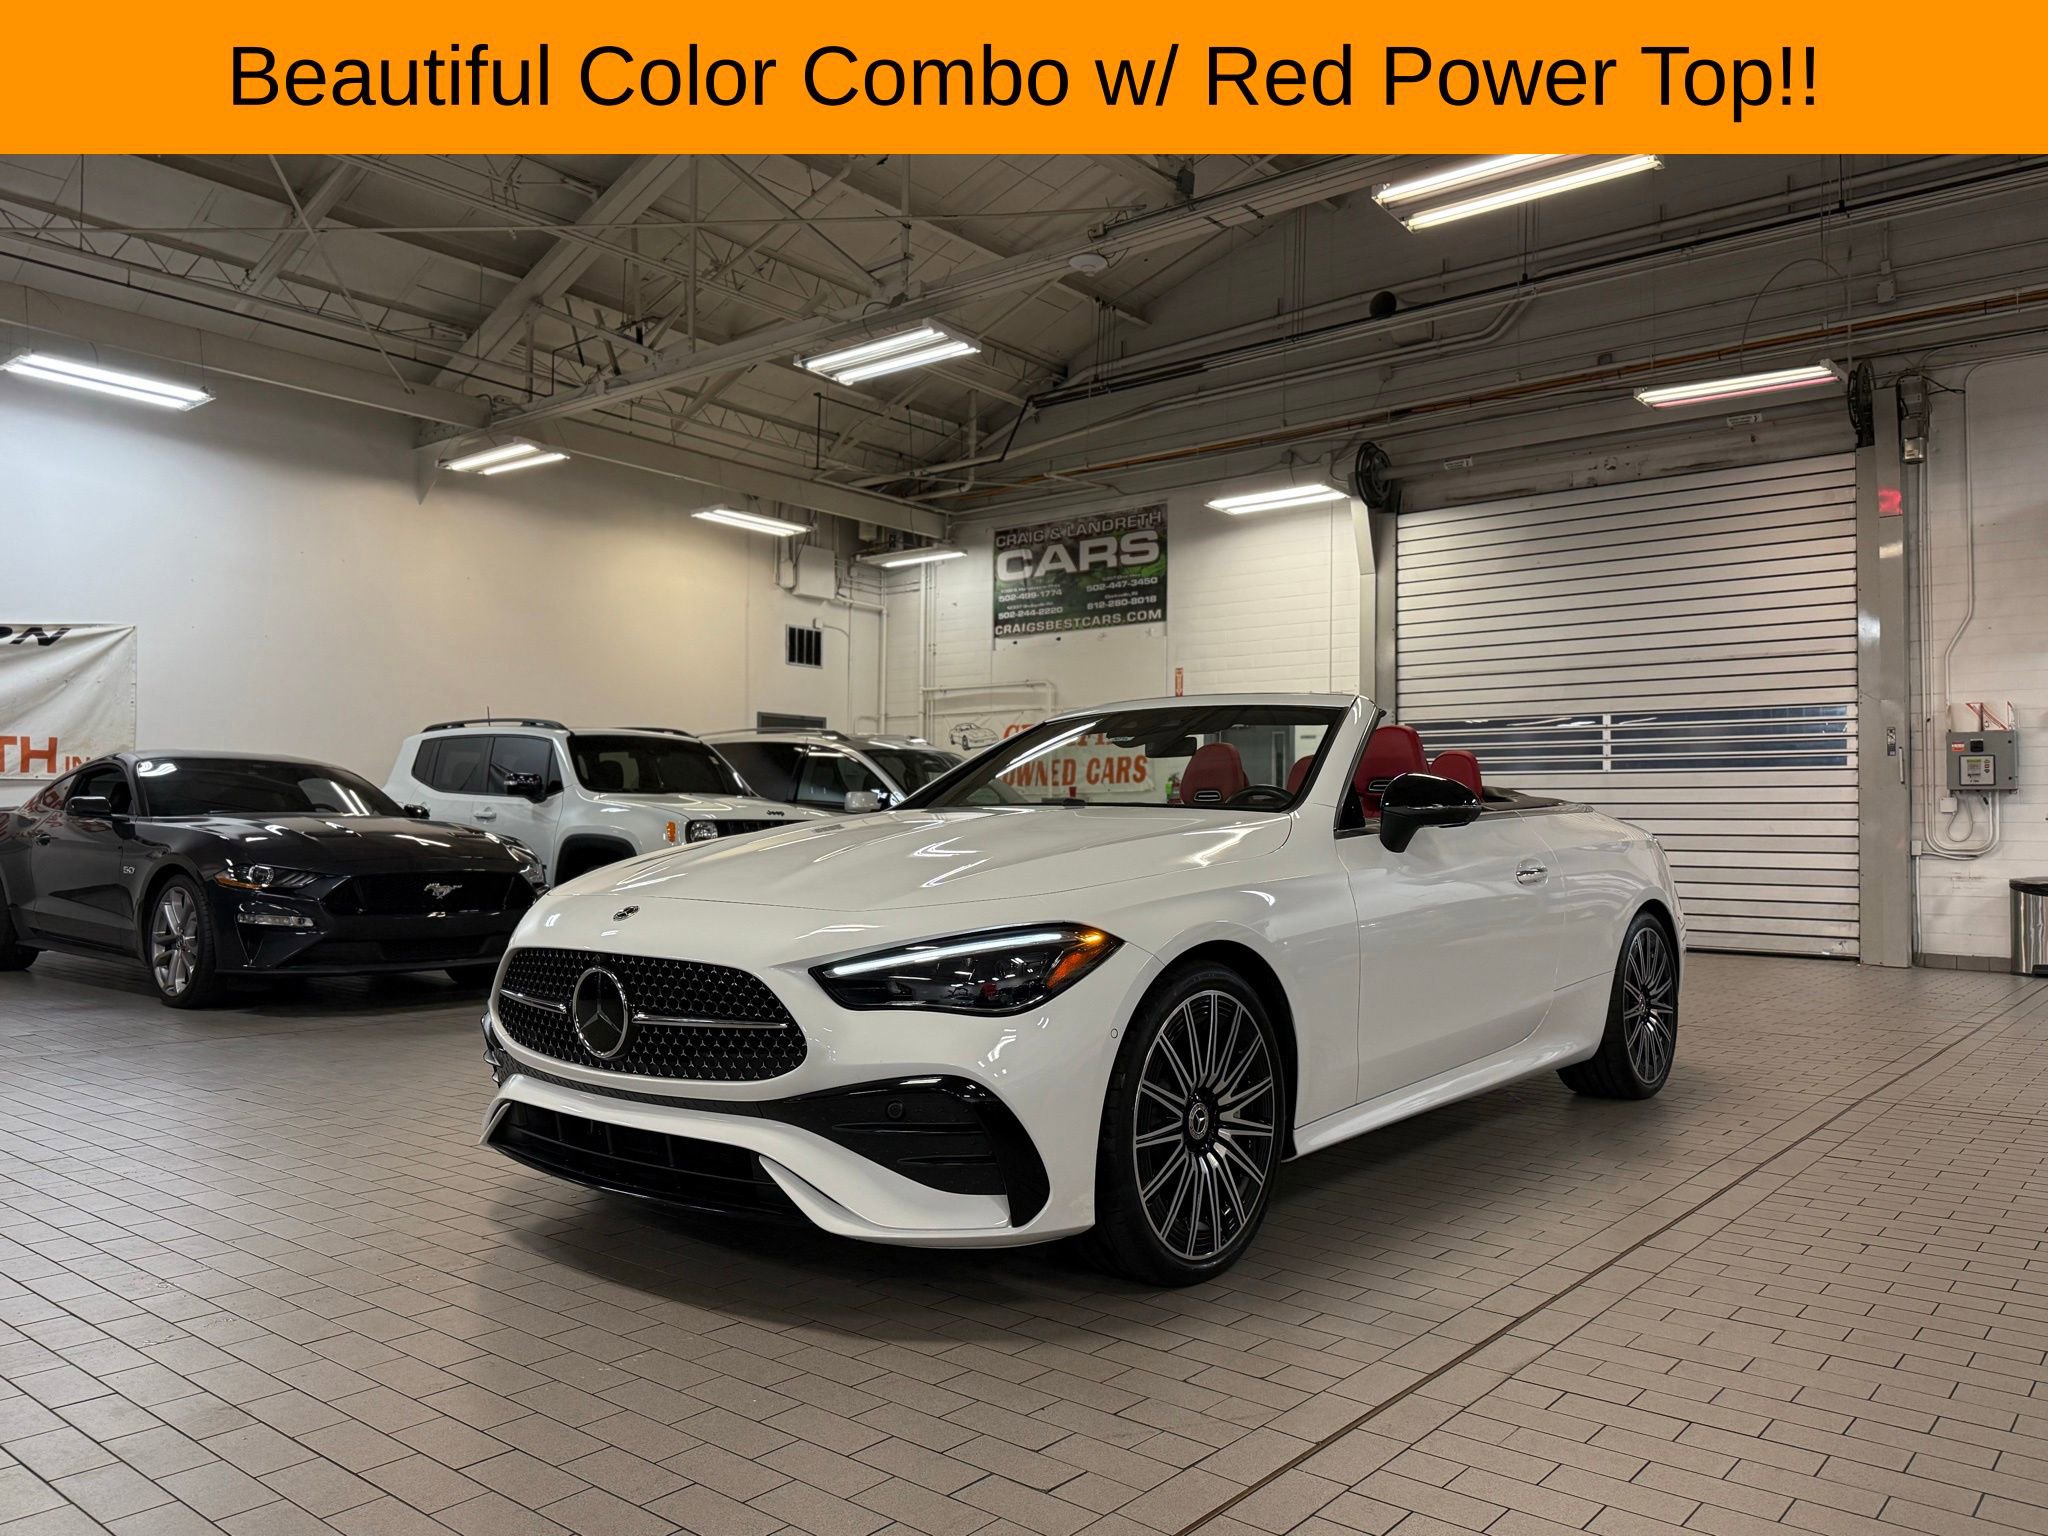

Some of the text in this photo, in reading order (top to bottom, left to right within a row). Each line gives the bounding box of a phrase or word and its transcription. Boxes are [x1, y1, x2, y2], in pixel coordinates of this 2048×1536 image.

[996, 511, 1162, 548] CRAIG & LANDRETH
[997, 530, 1160, 582] CARS
[995, 608, 1162, 636] CRAIGSBESTCARS.COM
[1086, 754, 1148, 785] CARS
